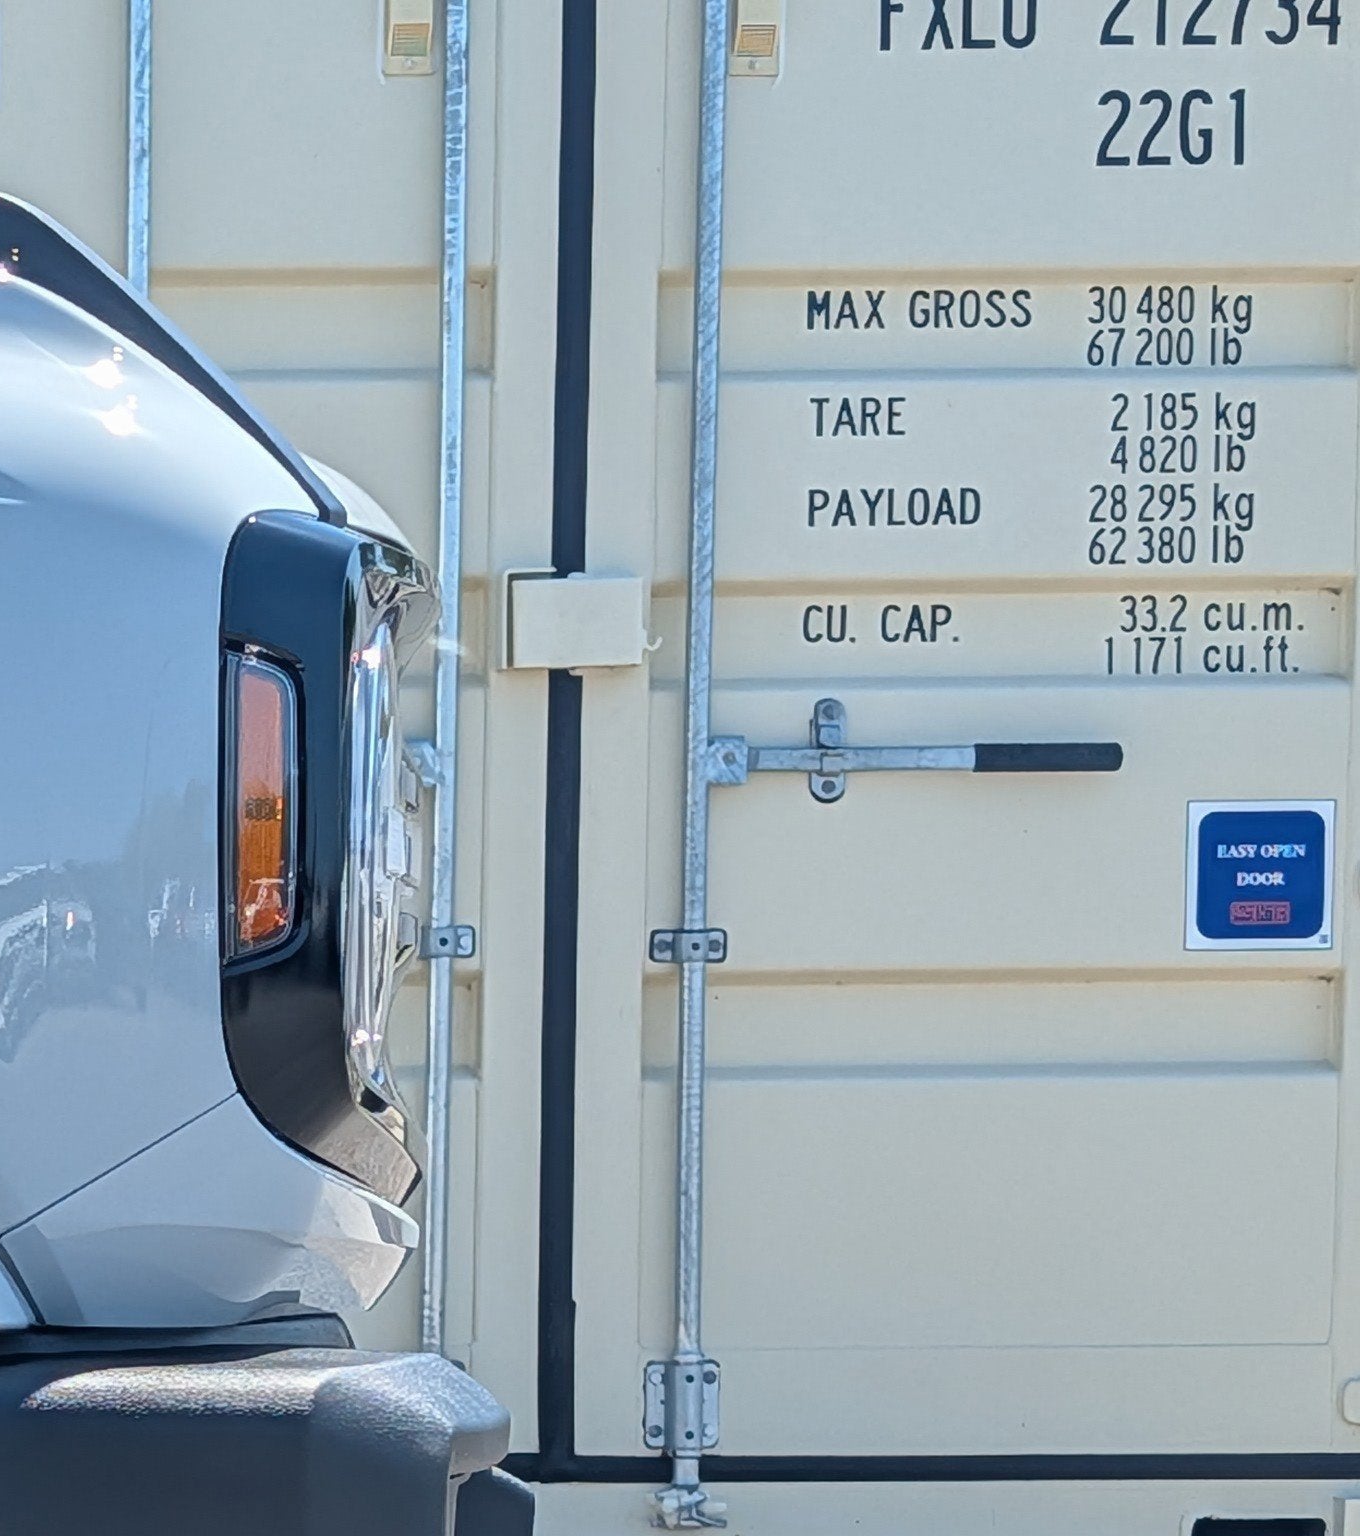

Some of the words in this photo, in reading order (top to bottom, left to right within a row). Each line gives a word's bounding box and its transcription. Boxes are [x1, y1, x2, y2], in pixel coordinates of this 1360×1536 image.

[1095, 88, 1247, 167] 22G1
[806, 289, 886, 331] MAX
[908, 288, 1033, 330] GROSS
[1210, 284, 1253, 333] kg
[1209, 326, 1243, 367] lb
[808, 396, 908, 437] TARE
[1213, 391, 1257, 440] kg
[1212, 434, 1246, 473] lb
[806, 487, 982, 528] PAYLOAD
[1211, 482, 1255, 532] kg
[1210, 524, 1245, 564] lb
[802, 604, 858, 644] CU.
[880, 604, 960, 644] CAP.
[1119, 593, 1188, 633] 33.2
[1202, 601, 1305, 633] cu.m.
[1202, 634, 1301, 675] cu.ft.
[1216, 843, 1258, 859] EASY
[1260, 843, 1307, 859] OPEN
[1236, 871, 1286, 887] DOOR
